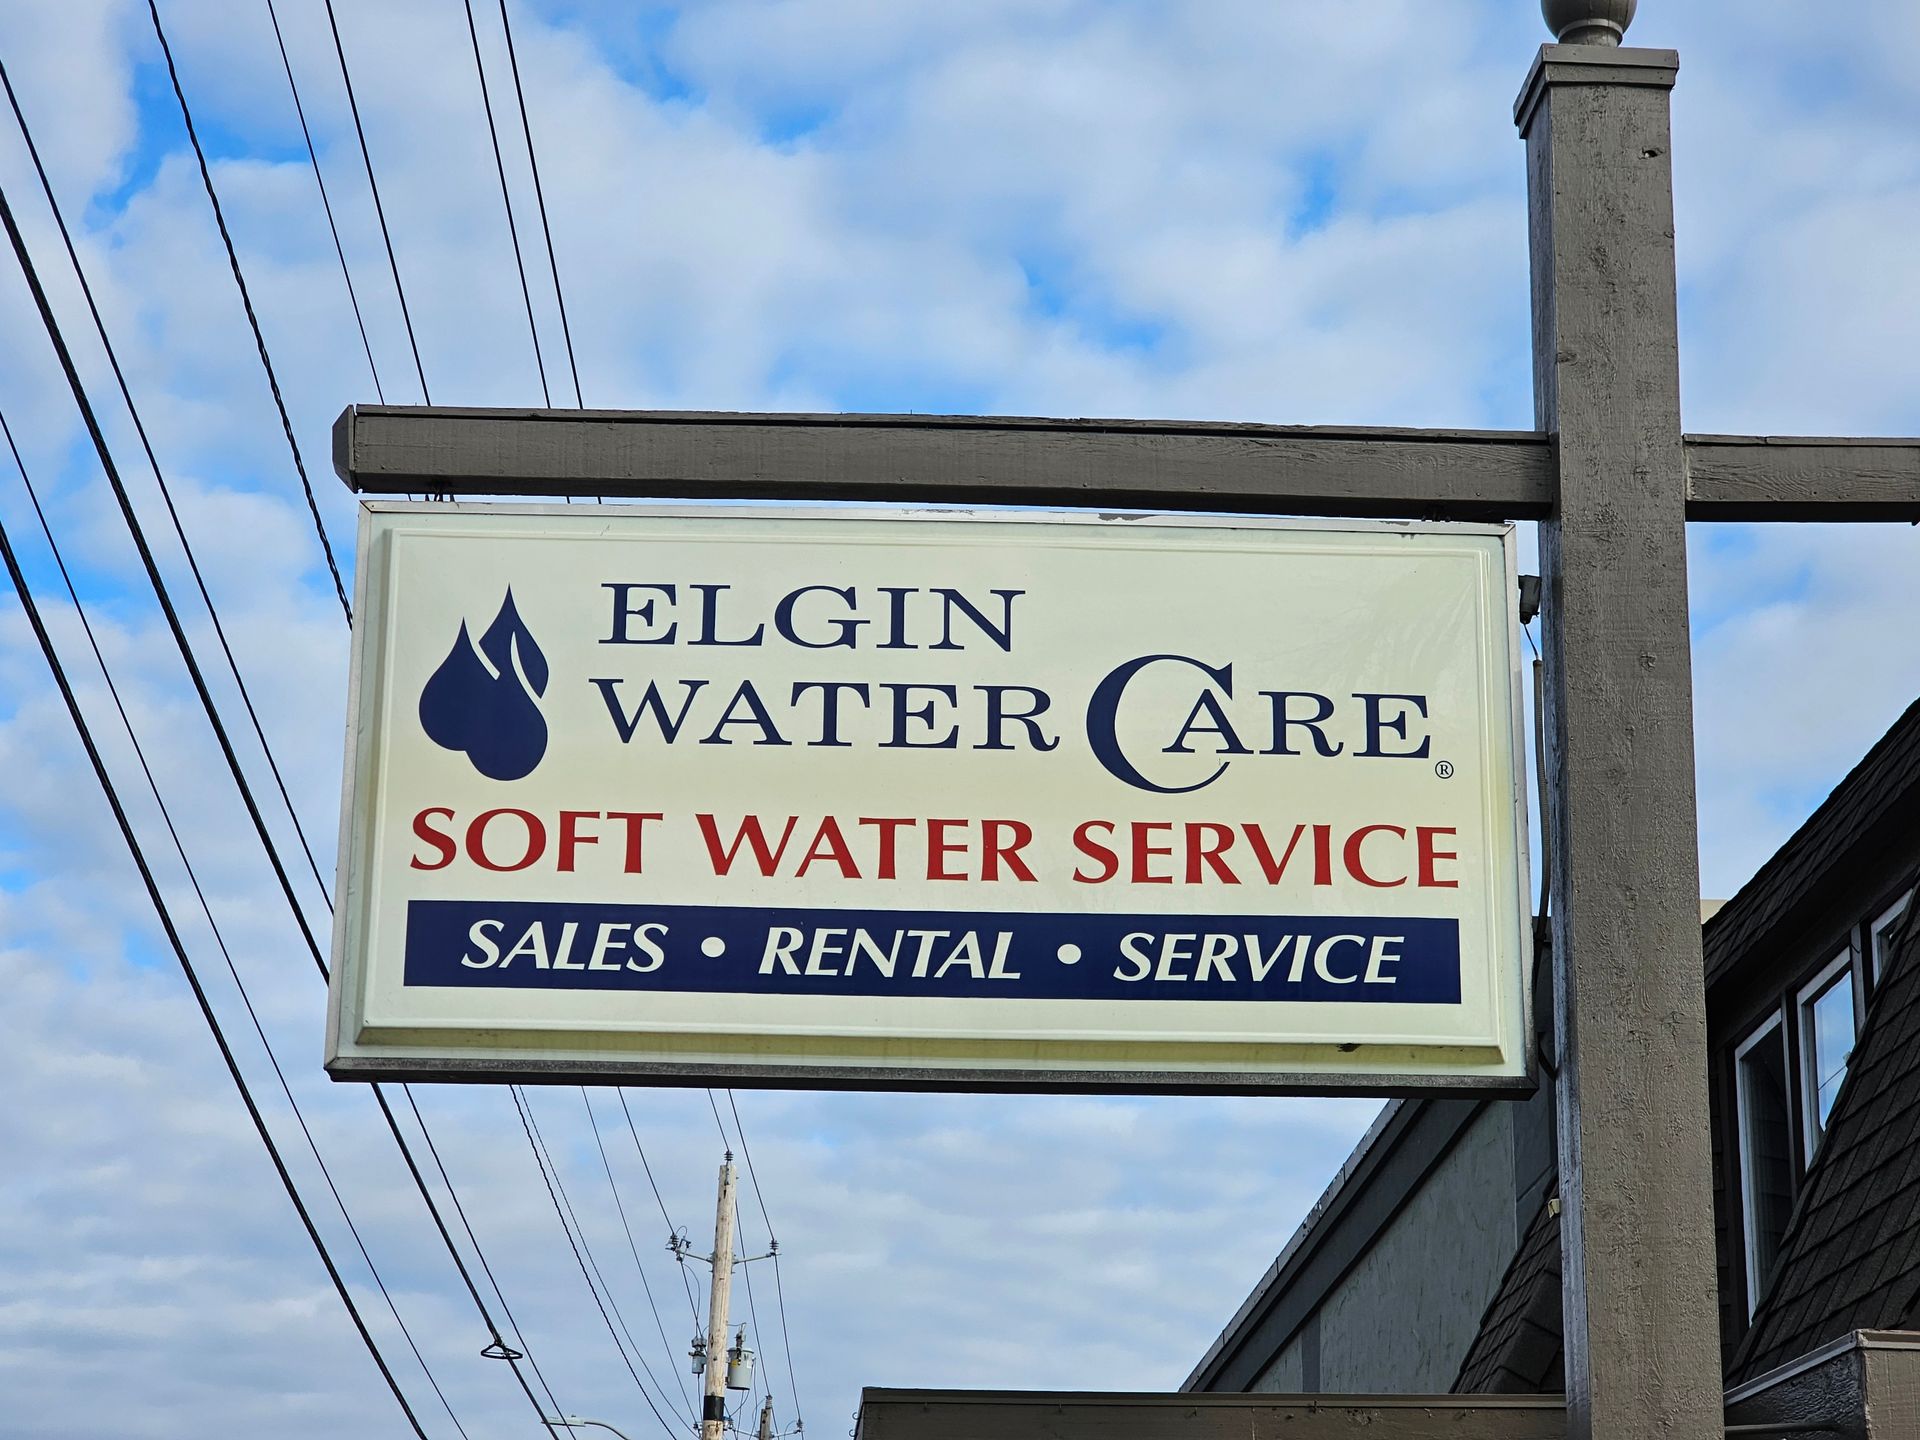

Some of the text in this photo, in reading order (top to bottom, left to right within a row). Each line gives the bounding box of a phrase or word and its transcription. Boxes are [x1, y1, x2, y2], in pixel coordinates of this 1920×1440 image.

[599, 583, 1026, 652] ELGIN
[589, 679, 1060, 751] WATER
[1086, 655, 1431, 793] CARE
[410, 807, 1460, 889] SOFT WATER SERVICE
[460, 920, 1405, 984] SALES RENTAL SERVICE
